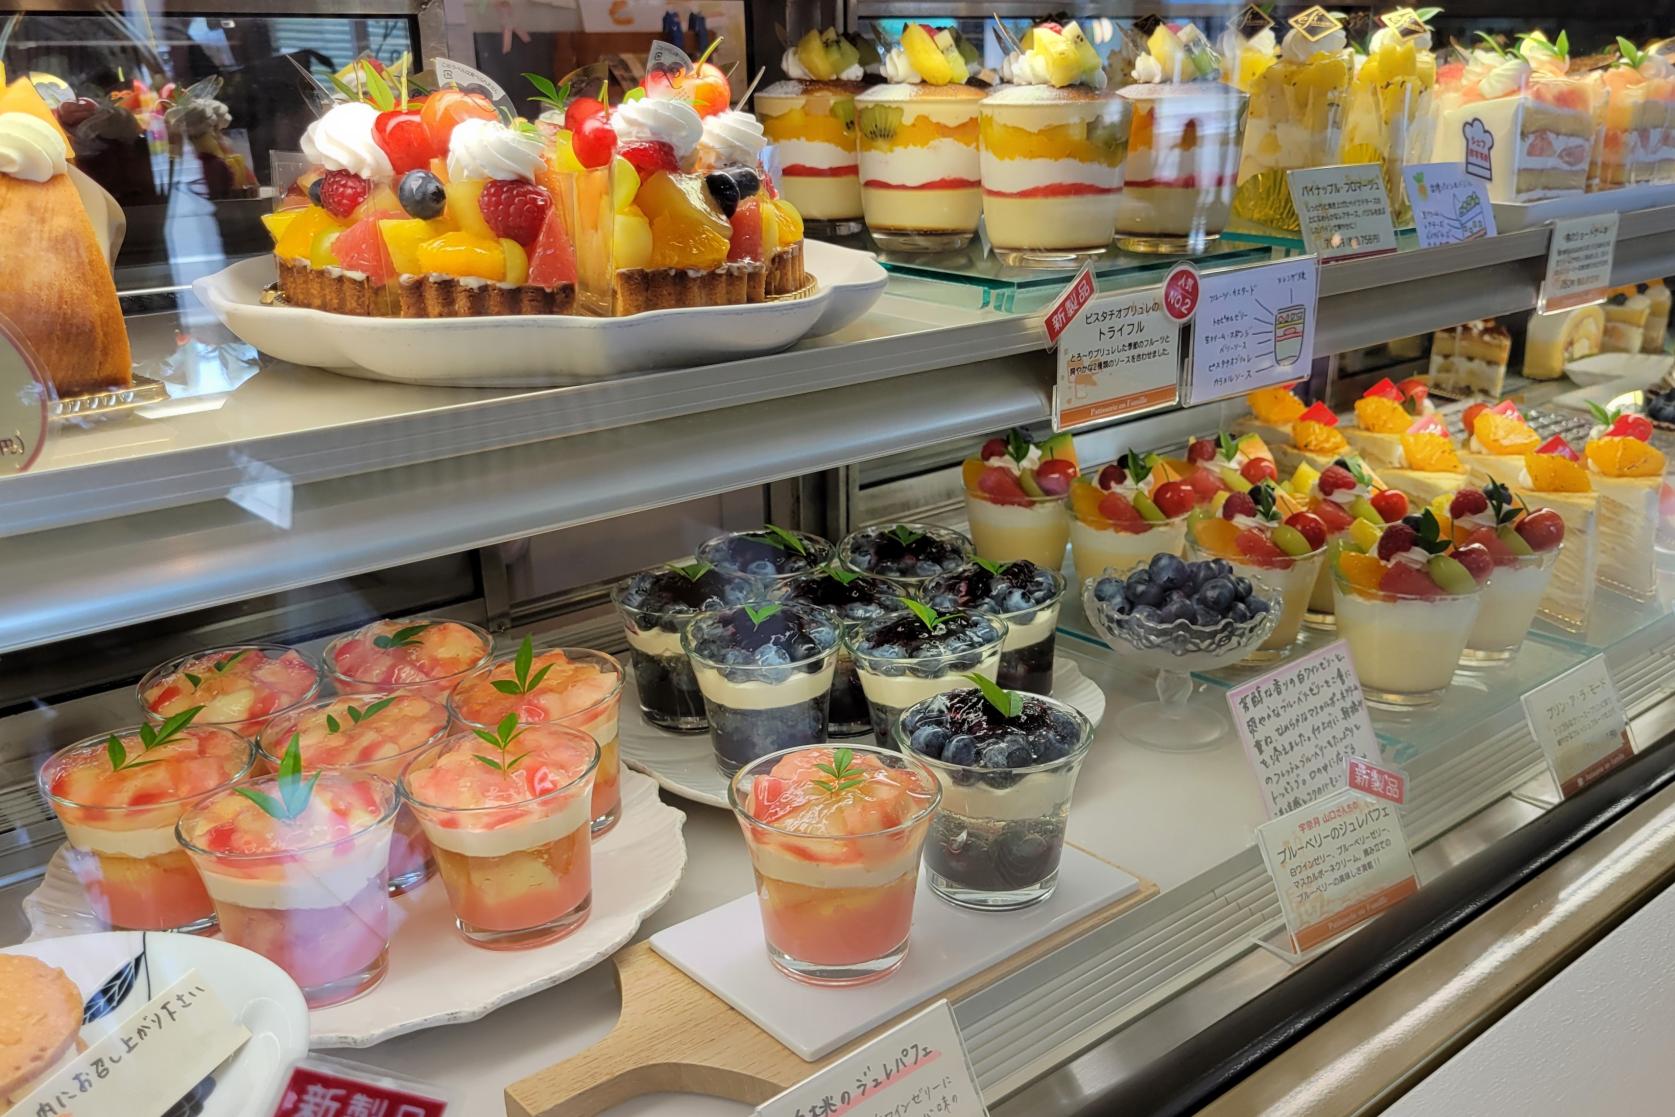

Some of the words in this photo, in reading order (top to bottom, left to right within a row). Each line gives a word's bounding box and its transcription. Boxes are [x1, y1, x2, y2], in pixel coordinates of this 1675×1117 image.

[1178, 274, 1194, 292] 人気
[1051, 280, 1090, 333] 新製品
[1085, 302, 1160, 326] ピスタチオブリュレの
[1168, 291, 1192, 314] NO.2
[1098, 321, 1145, 341] トライフル
[1354, 762, 1400, 799] 新製品
[1277, 806, 1390, 866] ブルーベリーのジュレパフェ
